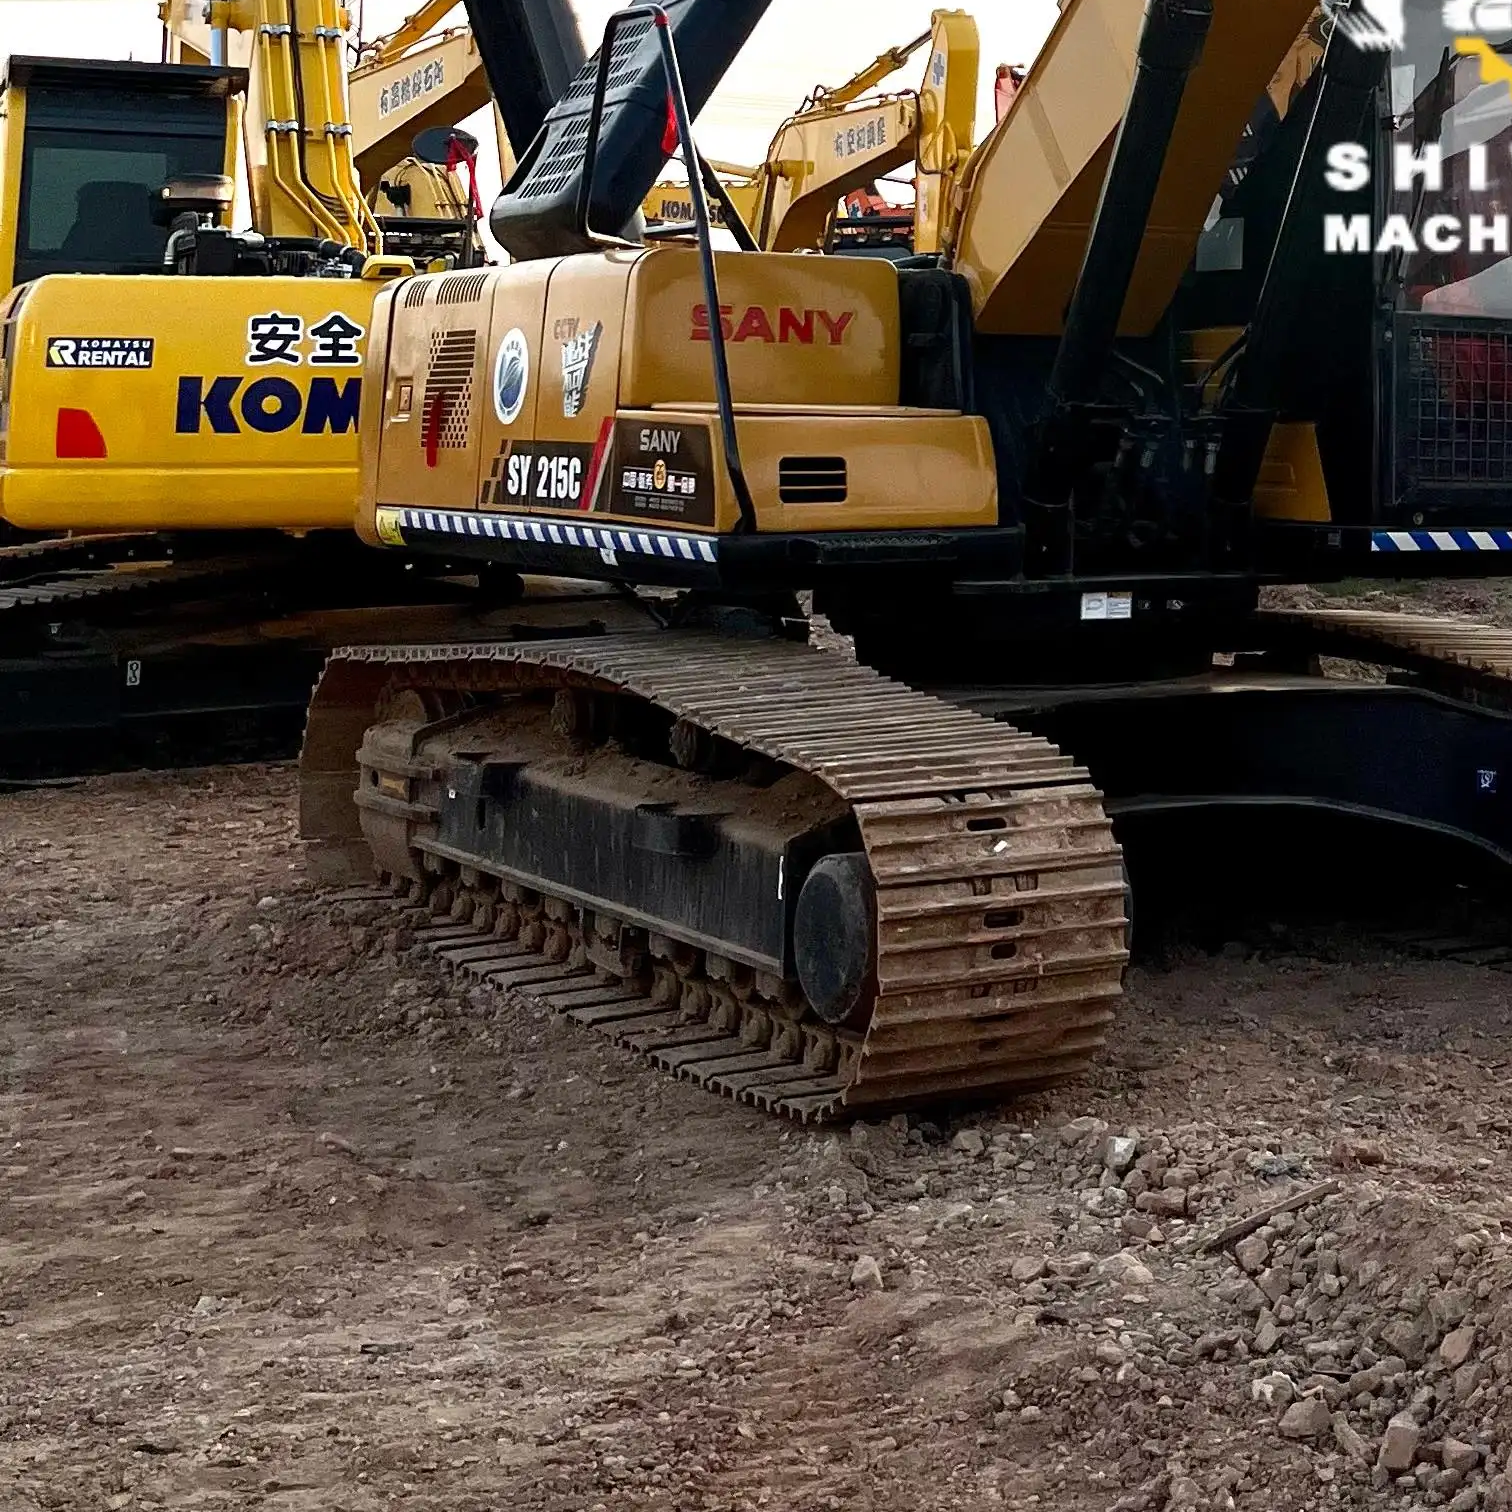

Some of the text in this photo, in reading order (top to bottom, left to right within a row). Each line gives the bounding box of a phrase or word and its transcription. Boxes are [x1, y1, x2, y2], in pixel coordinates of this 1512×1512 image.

[249, 313, 363, 365] 安全
[689, 303, 854, 346] SANY
[79, 351, 150, 366] RENTAL
[81, 340, 150, 349] KOMATSU
[639, 428, 681, 454] SANY
[507, 454, 582, 500] SY 215C
